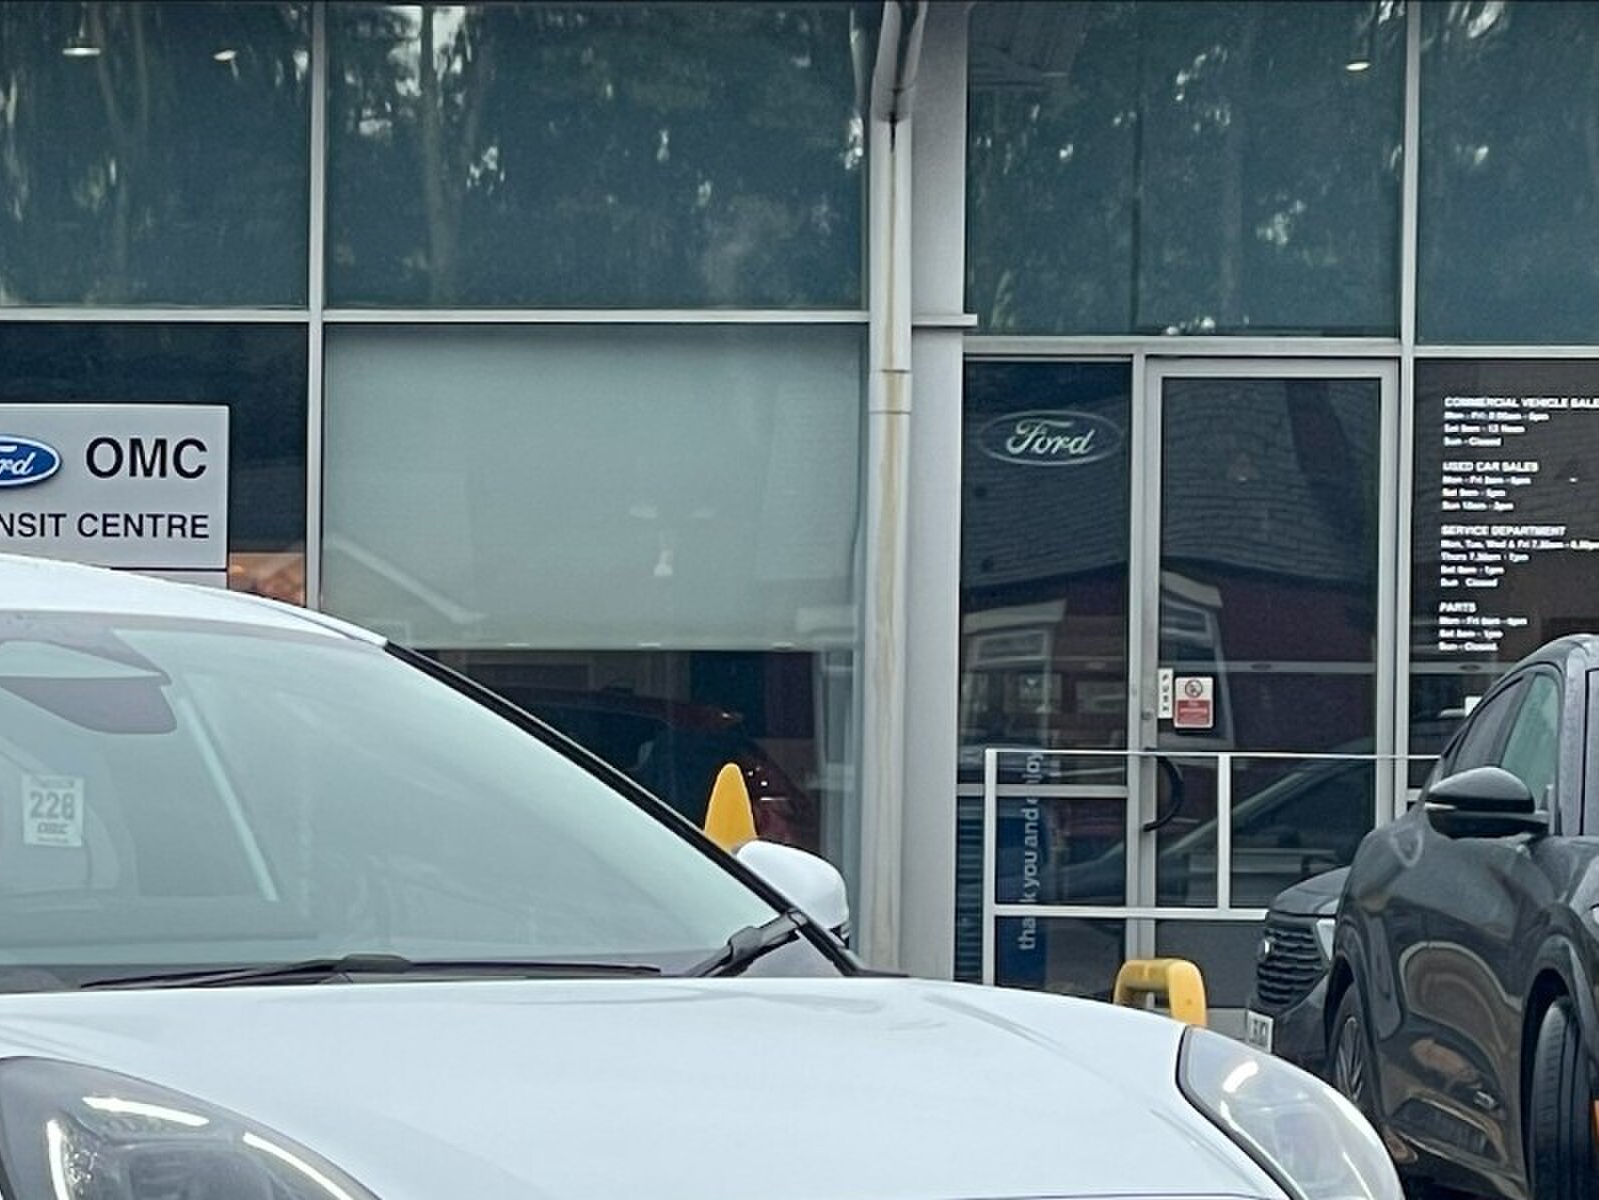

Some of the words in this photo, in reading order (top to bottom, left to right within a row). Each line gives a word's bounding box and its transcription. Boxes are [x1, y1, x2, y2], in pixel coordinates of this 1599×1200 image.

[1444, 397, 1520, 408] COMMERCIAL
[1521, 397, 1569, 408] VEHICLE
[1006, 417, 1097, 455] Ford
[85, 436, 209, 480] OMC
[1475, 461, 1500, 473] CAR
[1501, 461, 1539, 473] SALES
[77, 513, 210, 539] CENTRE
[1441, 525, 1489, 537] SERVICE
[1490, 525, 1567, 537] DEPARTMENT
[1439, 602, 1477, 613] PARTS
[29, 791, 75, 819] 228
[1021, 808, 1040, 847] and
[1024, 852, 1041, 888] you
[1017, 889, 1038, 950] thak
